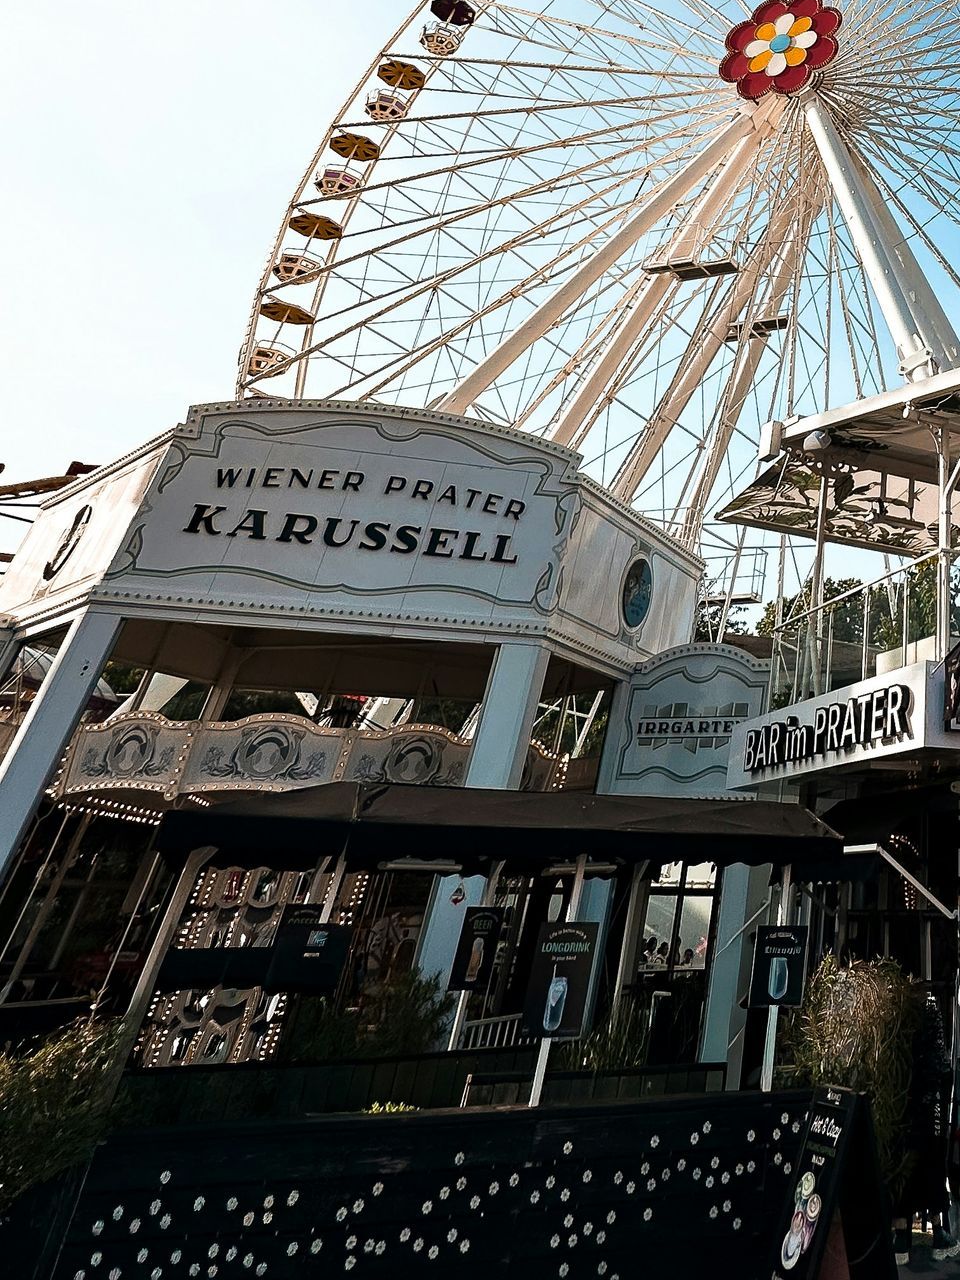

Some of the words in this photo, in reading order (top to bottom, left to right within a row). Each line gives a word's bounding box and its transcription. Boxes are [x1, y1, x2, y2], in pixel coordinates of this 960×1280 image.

[216, 468, 365, 491] WIENER
[383, 475, 527, 521] PRATER
[182, 502, 519, 564] KARUSSELL
[637, 721, 741, 734] IRRGARTE
[743, 721, 787, 772] BAR
[784, 716, 815, 762] im
[814, 683, 915, 753] PRATER
[541, 941, 591, 953] LONGDRINK
